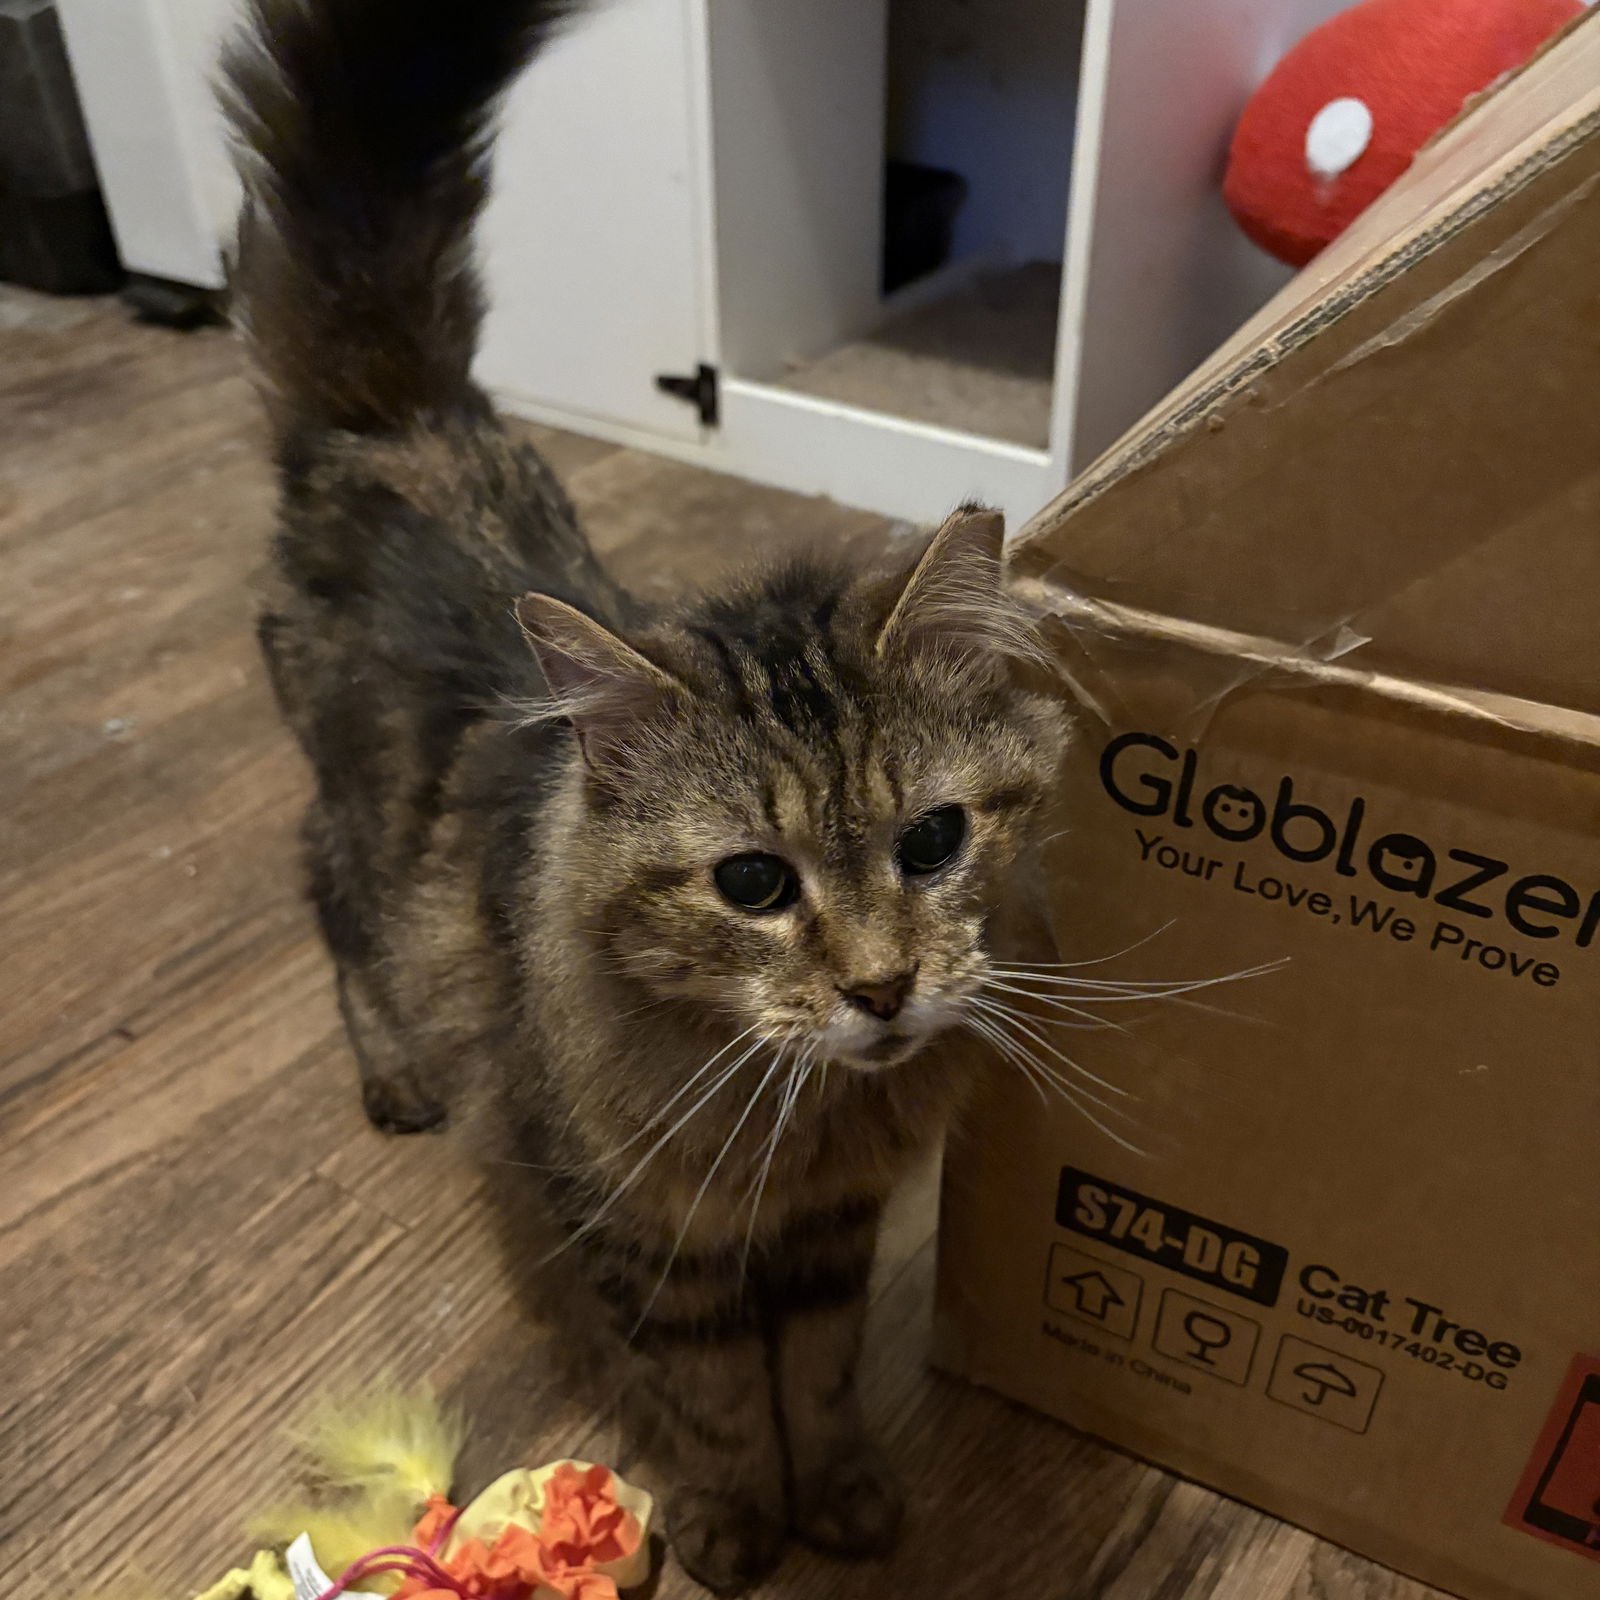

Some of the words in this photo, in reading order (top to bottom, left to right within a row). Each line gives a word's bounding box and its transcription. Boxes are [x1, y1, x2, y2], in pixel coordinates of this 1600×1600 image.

[1135, 828, 1224, 881] Your
[1430, 921, 1561, 987] Prove
[1074, 1183, 1261, 1290] S74-DG
[1296, 1299, 1509, 1391] US-0017402-DG
[1298, 1264, 1391, 1322] Cat
[1404, 1297, 1522, 1369] Tree
